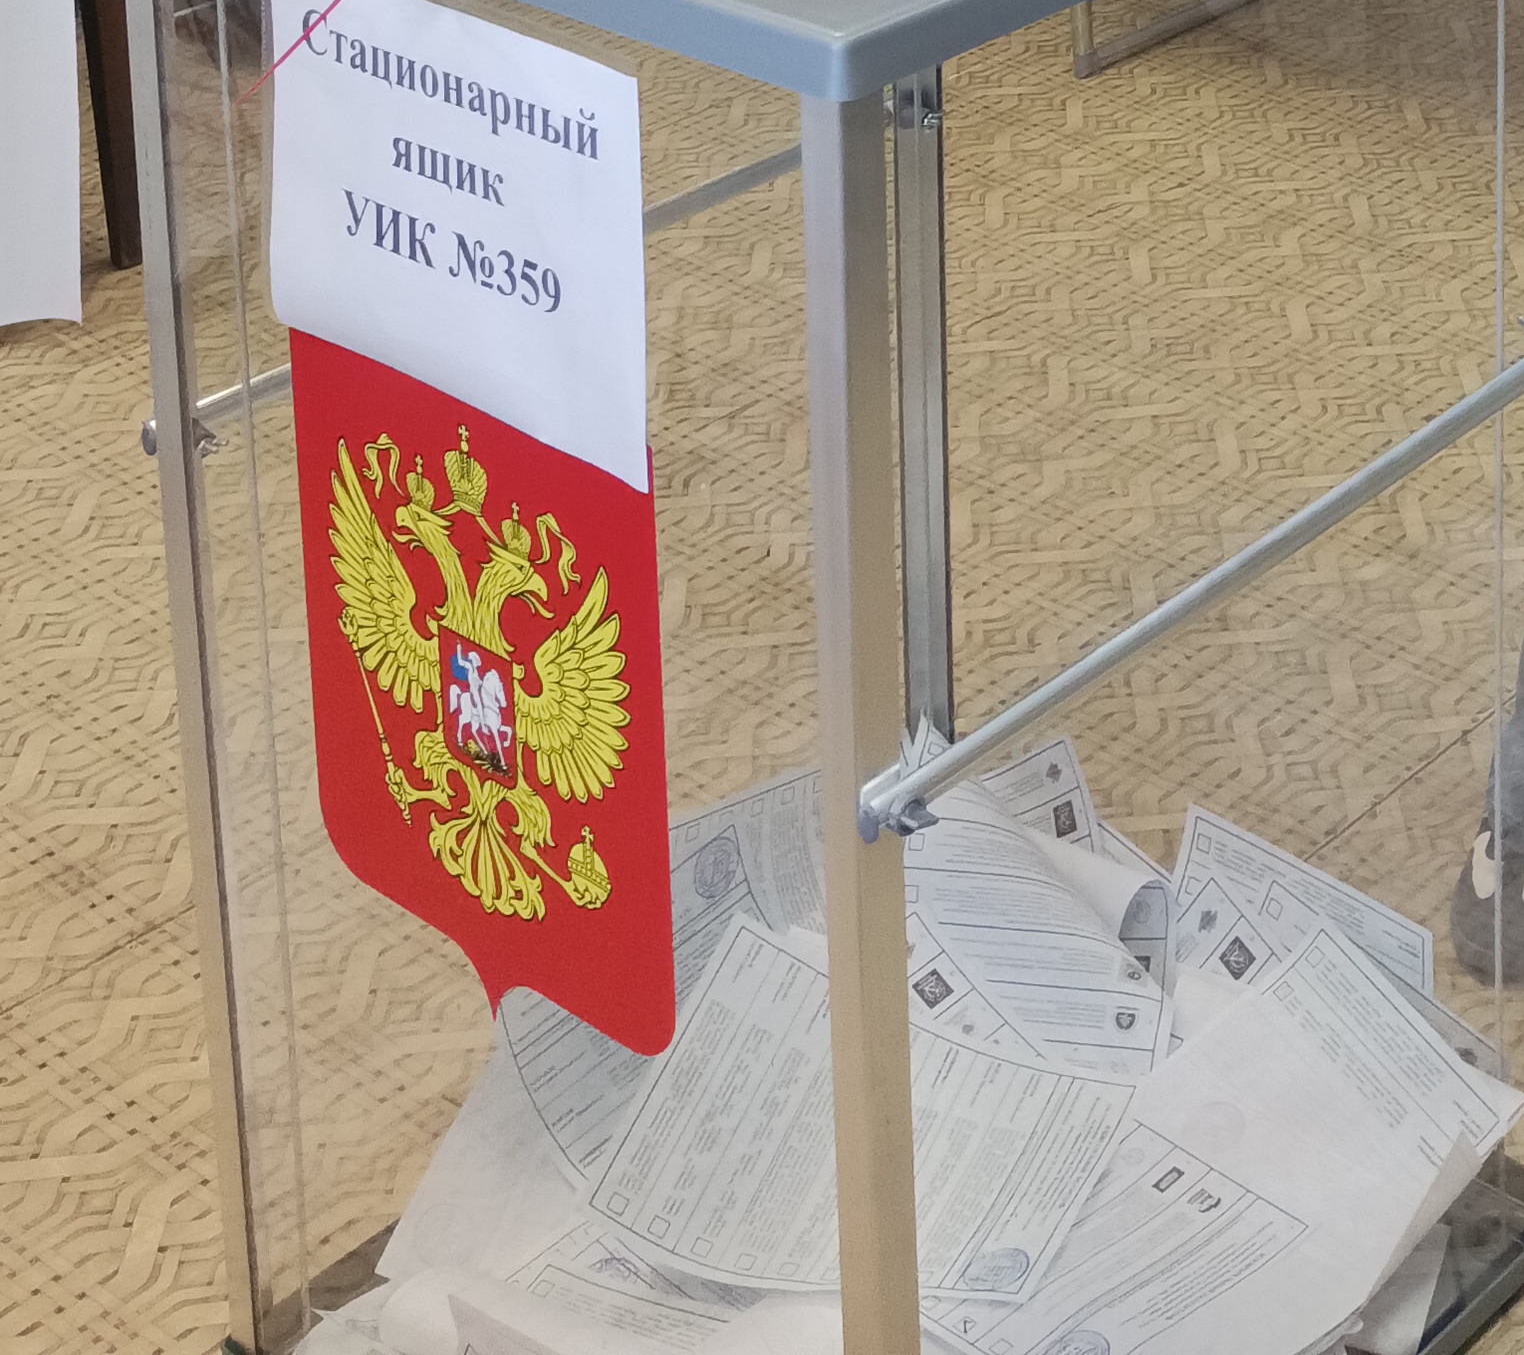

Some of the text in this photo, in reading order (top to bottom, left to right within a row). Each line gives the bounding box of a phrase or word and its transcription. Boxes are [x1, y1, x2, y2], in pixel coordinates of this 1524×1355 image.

[302, 8, 599, 160] Стационарный
[391, 136, 505, 207] ящик
[341, 188, 562, 314] УИК №359
